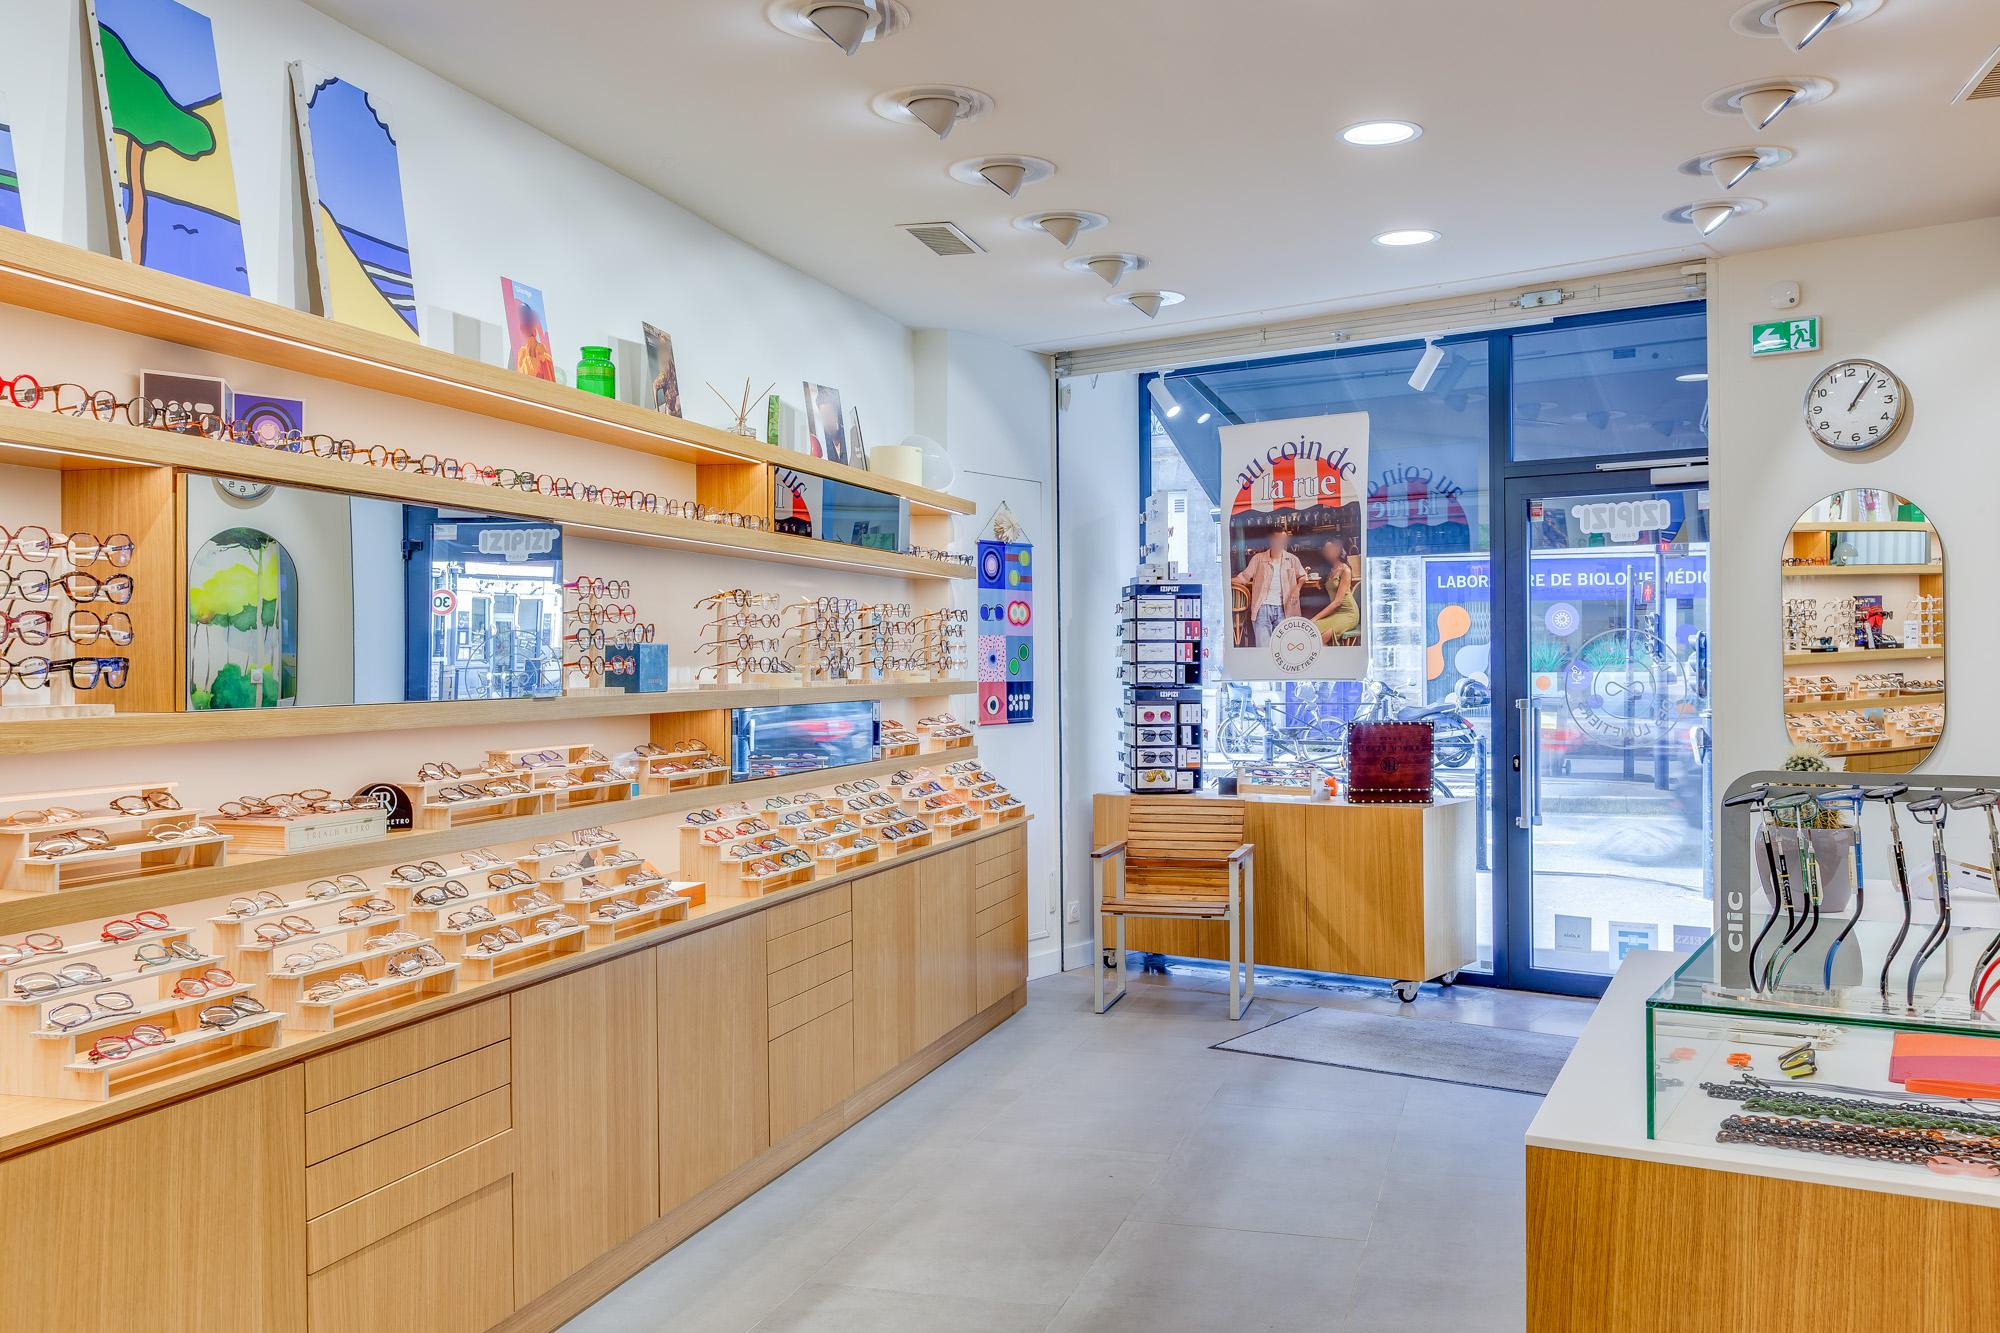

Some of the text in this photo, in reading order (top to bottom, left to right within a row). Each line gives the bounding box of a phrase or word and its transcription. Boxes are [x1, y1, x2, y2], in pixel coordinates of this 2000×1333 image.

[1843, 368, 1856, 378] 12
[1830, 375, 1838, 384] 11
[1876, 379, 1887, 389] 2
[1817, 388, 1827, 398] 10
[1884, 394, 1894, 404] 3
[1812, 405, 1823, 415] 9
[1880, 412, 1889, 421] 4
[1819, 421, 1830, 430] 8
[1868, 425, 1878, 435] 5
[1833, 430, 1842, 440] 7
[1851, 432, 1861, 442] 6
[1236, 435, 1357, 491] au coin de
[1261, 473, 1285, 501] la
[1292, 474, 1336, 498] rue
[481, 532, 550, 551] IZIPIZI
[1551, 573, 1572, 586] DE
[1577, 571, 1654, 586] BIOLOIE
[1275, 622, 1318, 639] LE COLLECTIF
[1274, 651, 1318, 672] DES LUNETIERS
[1727, 891, 1744, 953] clic
